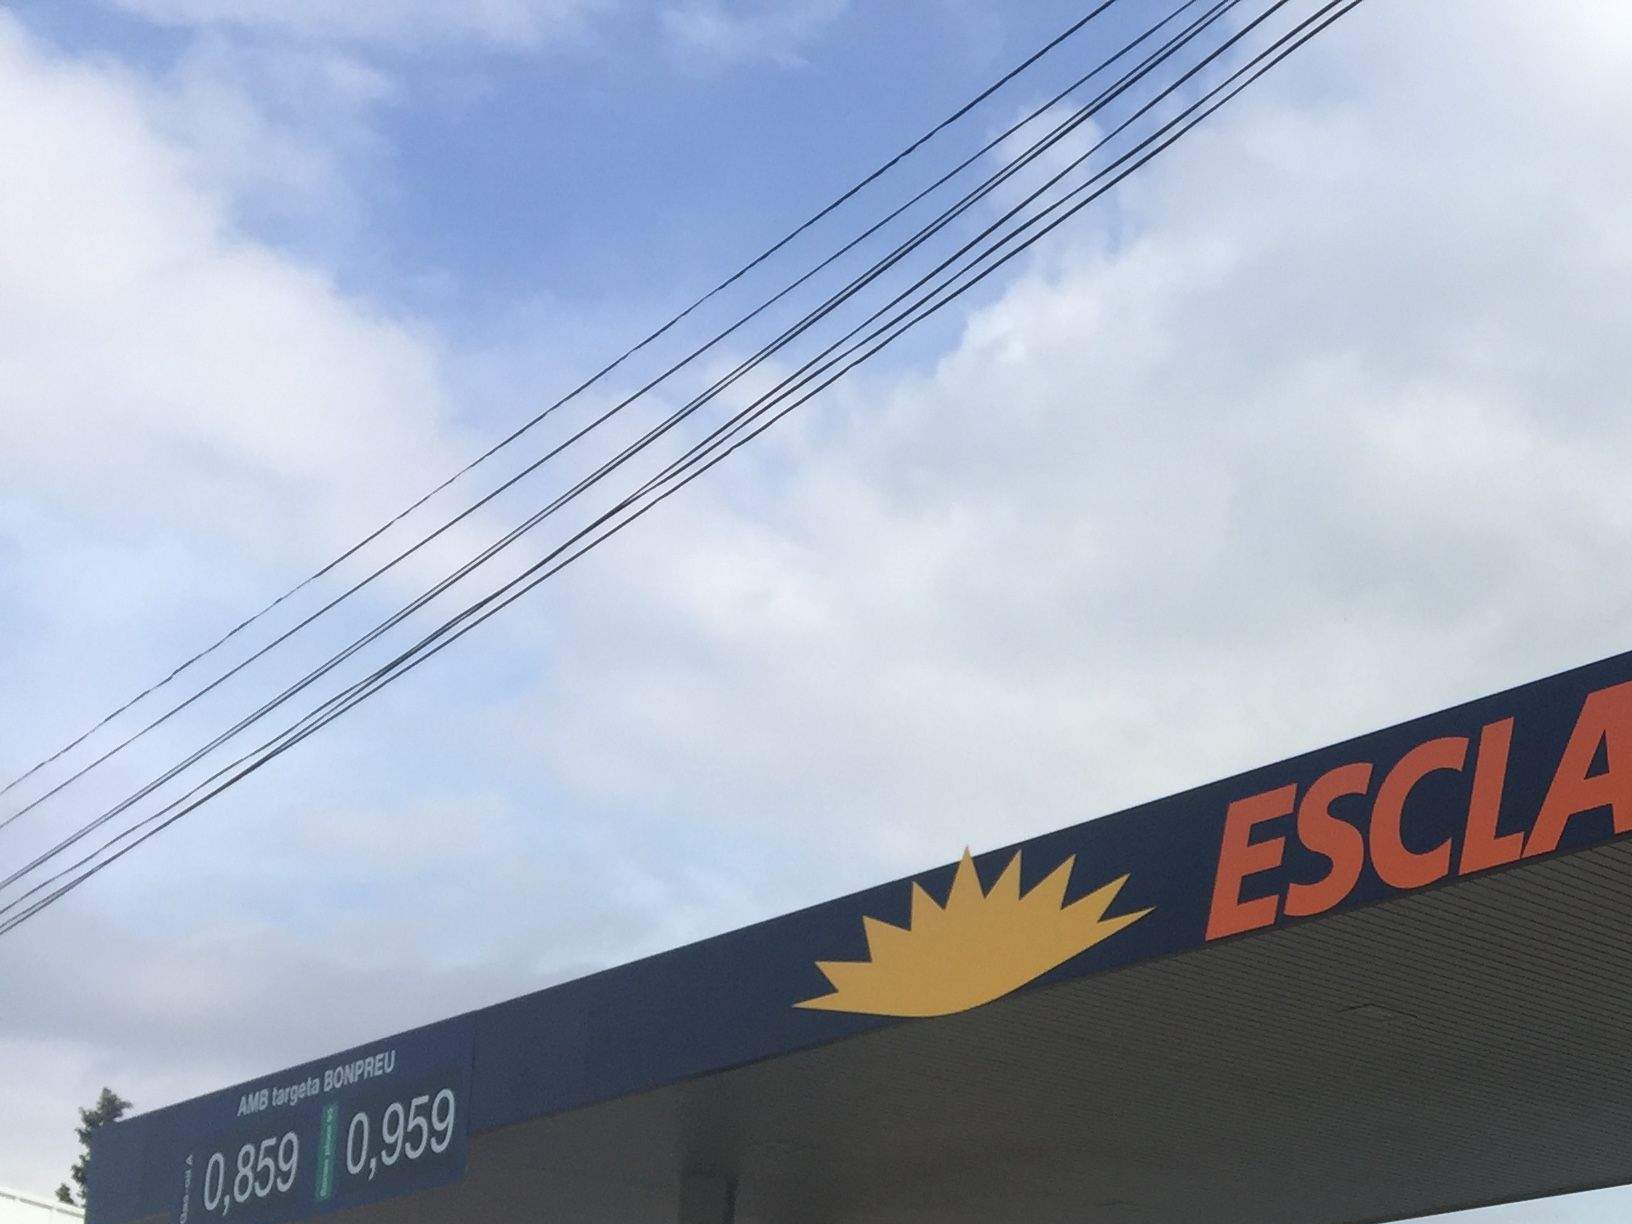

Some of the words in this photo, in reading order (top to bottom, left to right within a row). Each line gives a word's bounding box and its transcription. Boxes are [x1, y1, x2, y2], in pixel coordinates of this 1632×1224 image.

[236, 1088, 269, 1117] AMB
[272, 1077, 320, 1106] targeta
[323, 1050, 396, 1092] BONPREU
[203, 1131, 299, 1216] 0,859
[346, 1088, 455, 1181] 0,959
